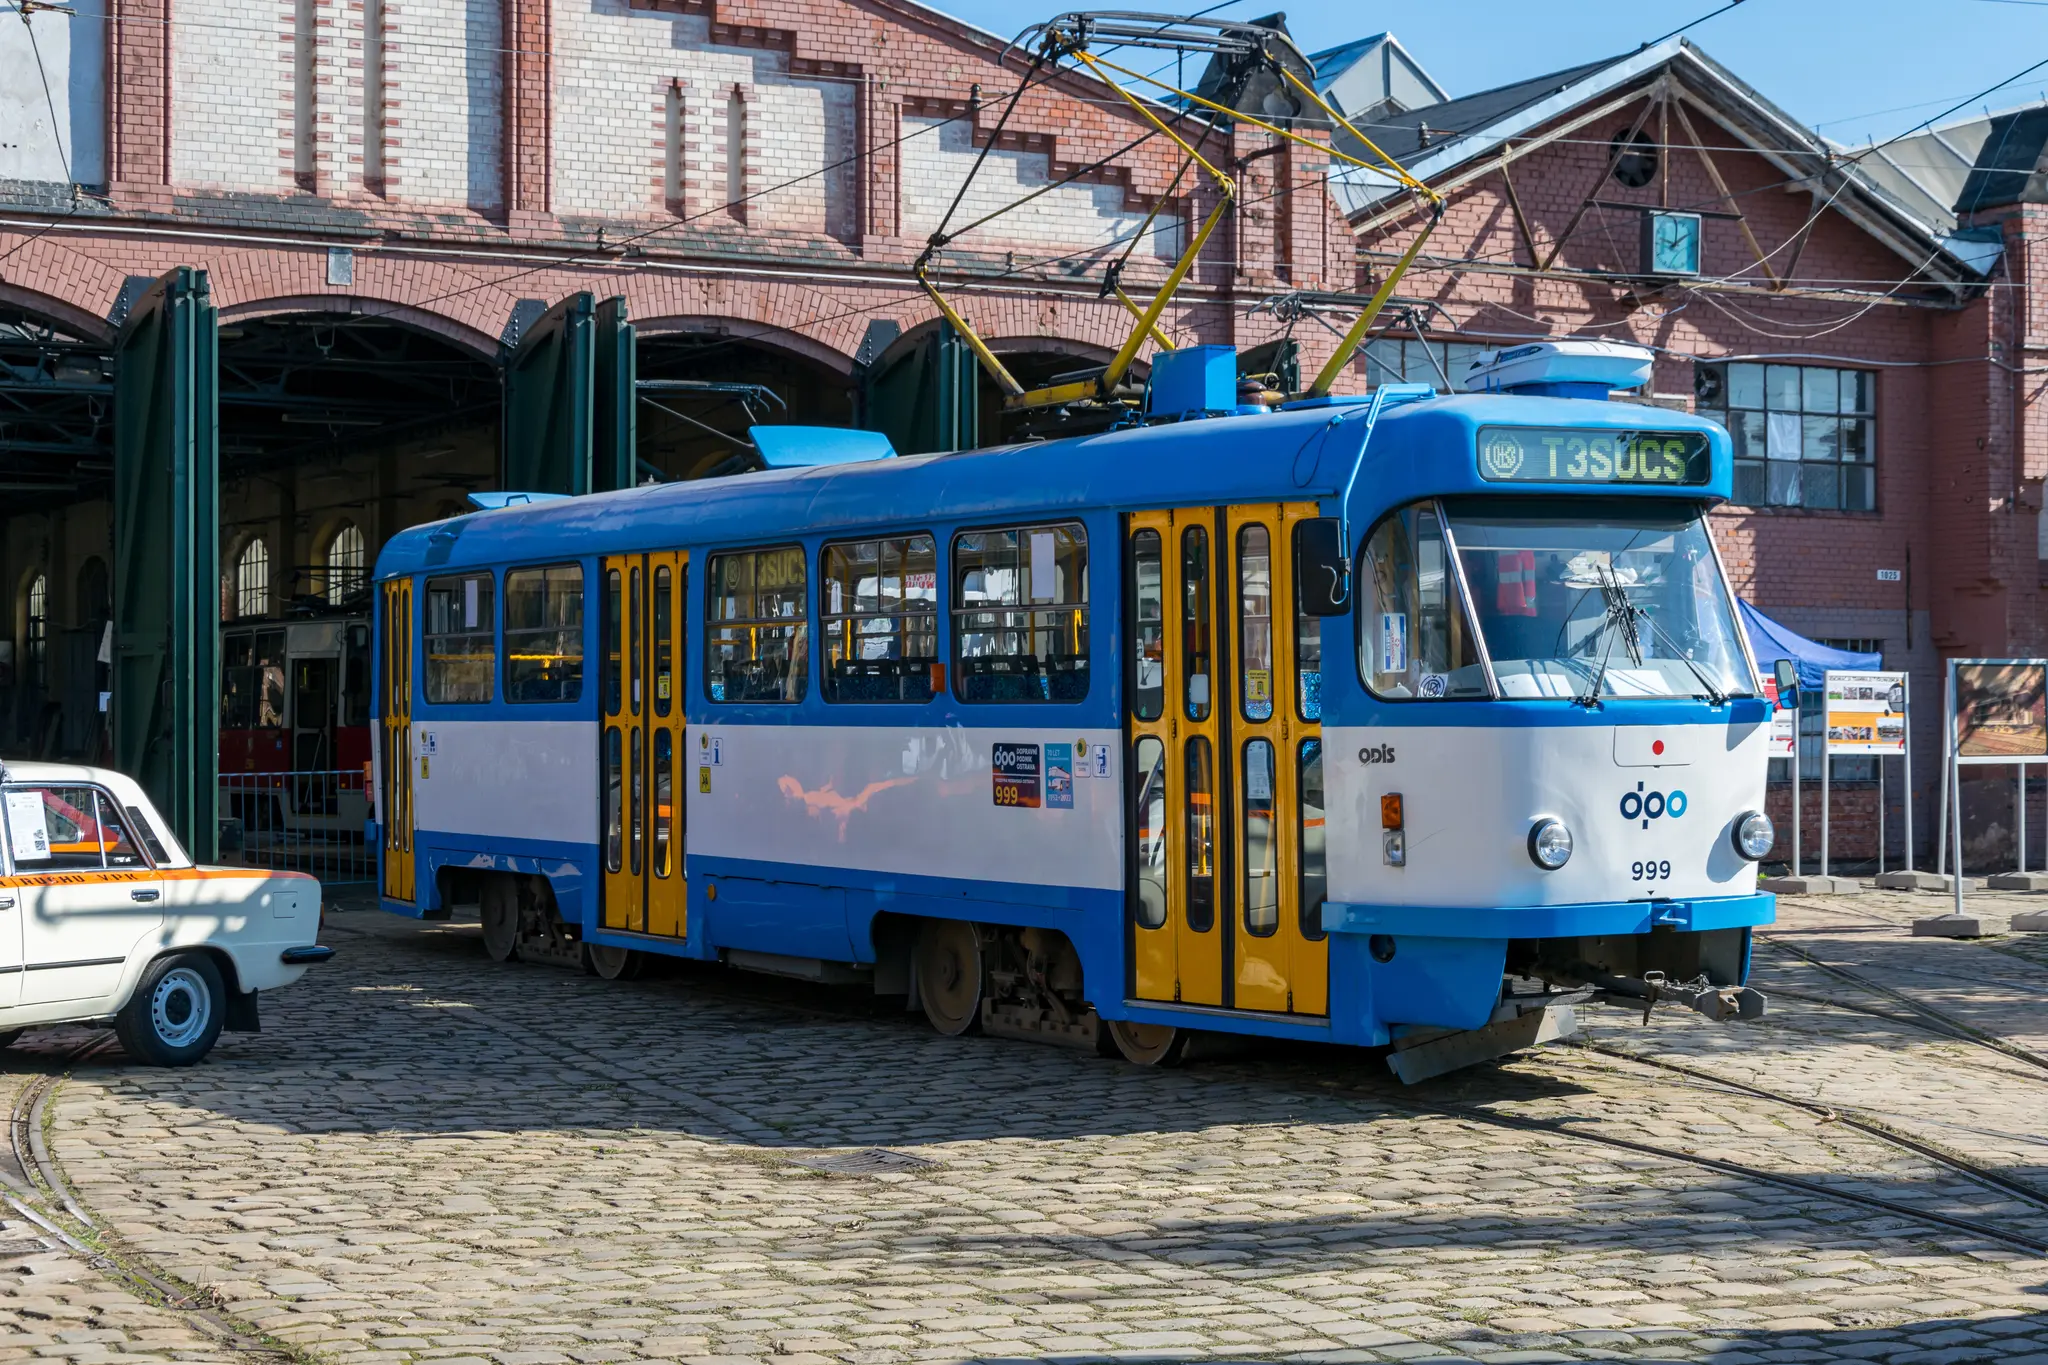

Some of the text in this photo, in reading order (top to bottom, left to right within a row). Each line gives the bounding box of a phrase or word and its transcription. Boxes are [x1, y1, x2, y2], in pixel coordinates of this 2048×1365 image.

[1541, 436, 1686, 480] T3SUCS
[1881, 571, 1898, 580] 1025
[995, 785, 1018, 804] 999
[1620, 781, 1688, 830] dpo
[1631, 860, 1671, 881] 999
